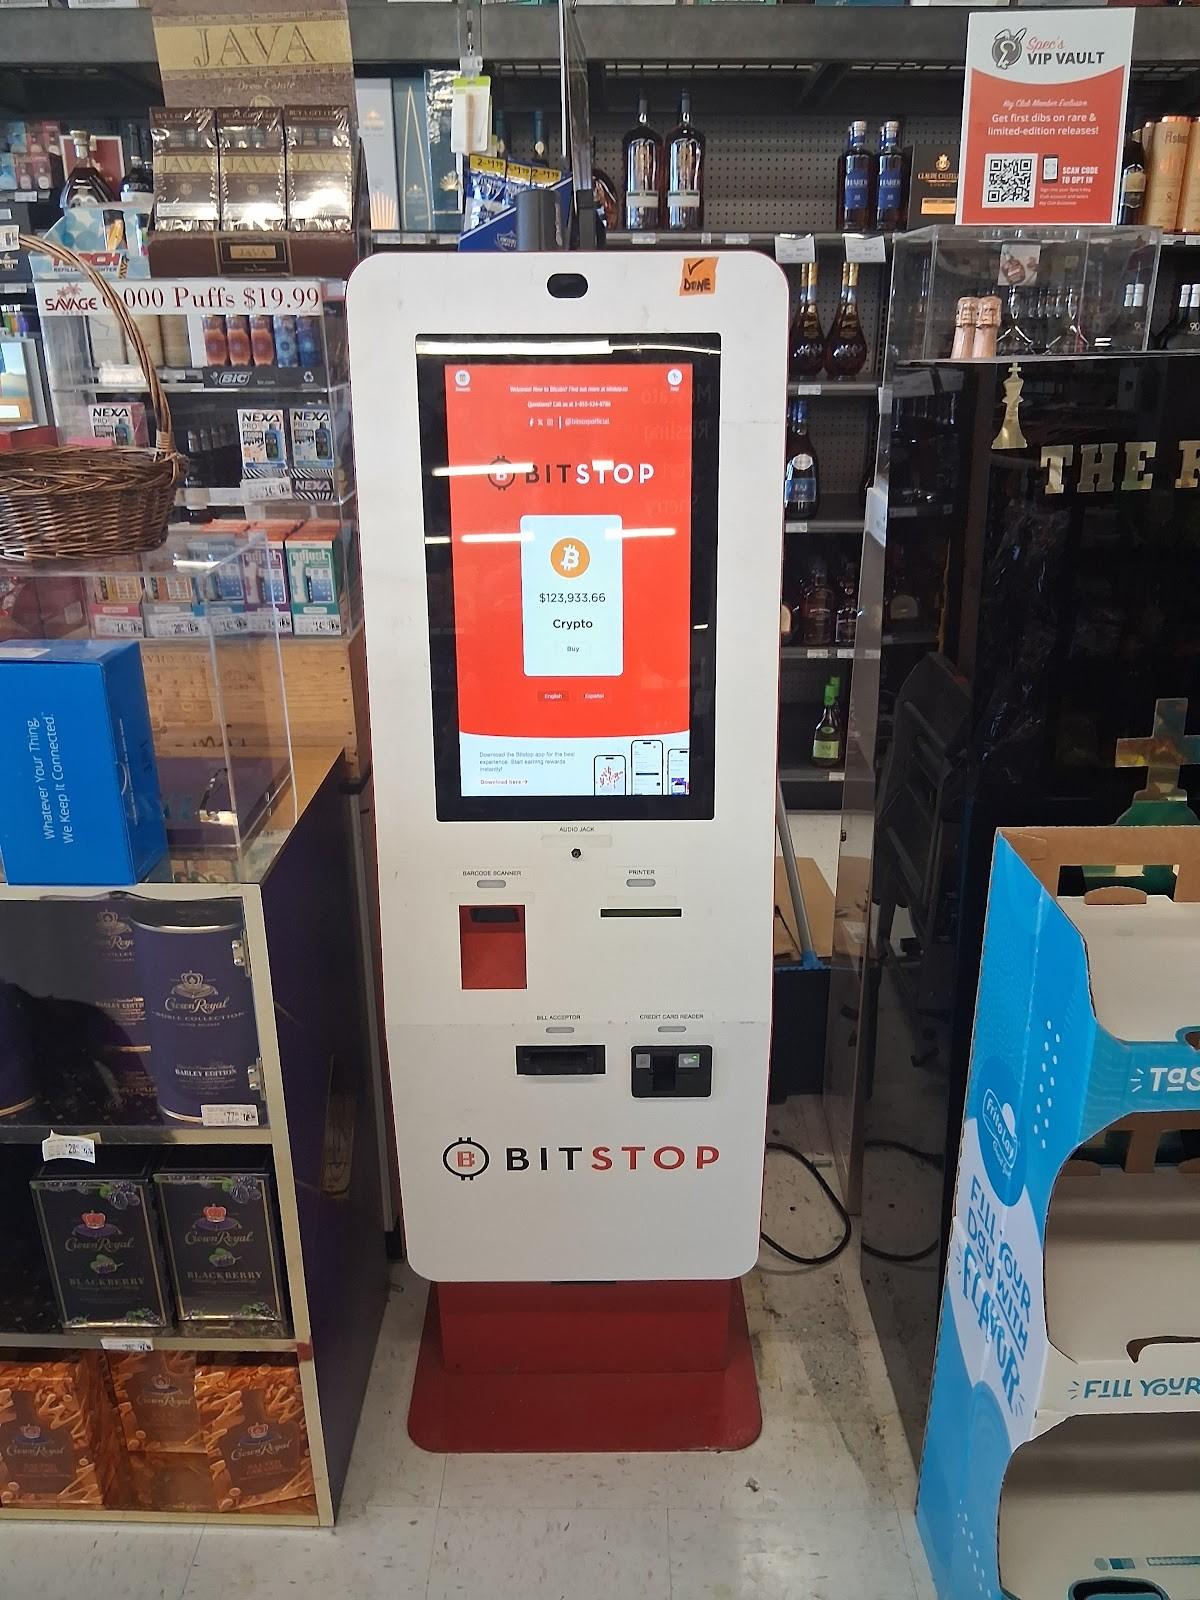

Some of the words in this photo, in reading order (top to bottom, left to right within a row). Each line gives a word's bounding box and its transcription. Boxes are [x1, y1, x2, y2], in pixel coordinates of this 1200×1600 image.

[194, 25, 316, 67] JAVA
[1026, 36, 1065, 51] Spec's
[1028, 53, 1051, 65] VIP
[1056, 52, 1105, 65] VAULT
[992, 114, 1008, 123] Get
[1010, 114, 1029, 122] first
[1031, 113, 1051, 122] dibs
[1067, 114, 1087, 122] rare
[1089, 113, 1097, 122] &
[988, 126, 1055, 136] limited-edition
[1058, 125, 1099, 136] releases!
[1062, 166, 1080, 175] SCAN
[1081, 166, 1099, 175] CODE
[1062, 176, 1070, 184] TO
[1071, 176, 1084, 184] OPT
[684, 278, 711, 291] DONE
[174, 287, 236, 309] Puffs
[243, 286, 320, 309] $19.99
[45, 298, 98, 311] SAVAGE
[221, 373, 249, 384] BIC
[93, 408, 129, 417] NEXA
[242, 412, 280, 422] NEXA
[293, 411, 329, 421] NEXA
[526, 463, 655, 484] BITSTOP
[1040, 441, 1157, 494] THE
[295, 481, 331, 491] NEXA
[539, 592, 606, 605] $123,933.66
[552, 619, 593, 631] Crypto
[34, 756, 47, 784] Your
[55, 783, 65, 791] It
[38, 788, 56, 841] Whatever
[58, 793, 71, 823] Keep
[62, 825, 74, 844] We
[190, 996, 230, 1014] Royal
[175, 1068, 203, 1077] BARLEY
[204, 1068, 238, 1077] EDITION
[505, 1146, 720, 1171] BITSTOP
[65, 1237, 100, 1251] Crown
[96, 1236, 135, 1253] Royal
[185, 1231, 218, 1246] Crown
[214, 1231, 254, 1247] Royal
[970, 1175, 996, 1244] FILL
[999, 1231, 1031, 1323] YOUR
[69, 1277, 145, 1286] BLACKBERRY
[187, 1271, 263, 1280] BLACKBERRY
[996, 1268, 1028, 1353] WITH
[1083, 1379, 1133, 1399] FILL
[1140, 1377, 1200, 1397] YOUR
